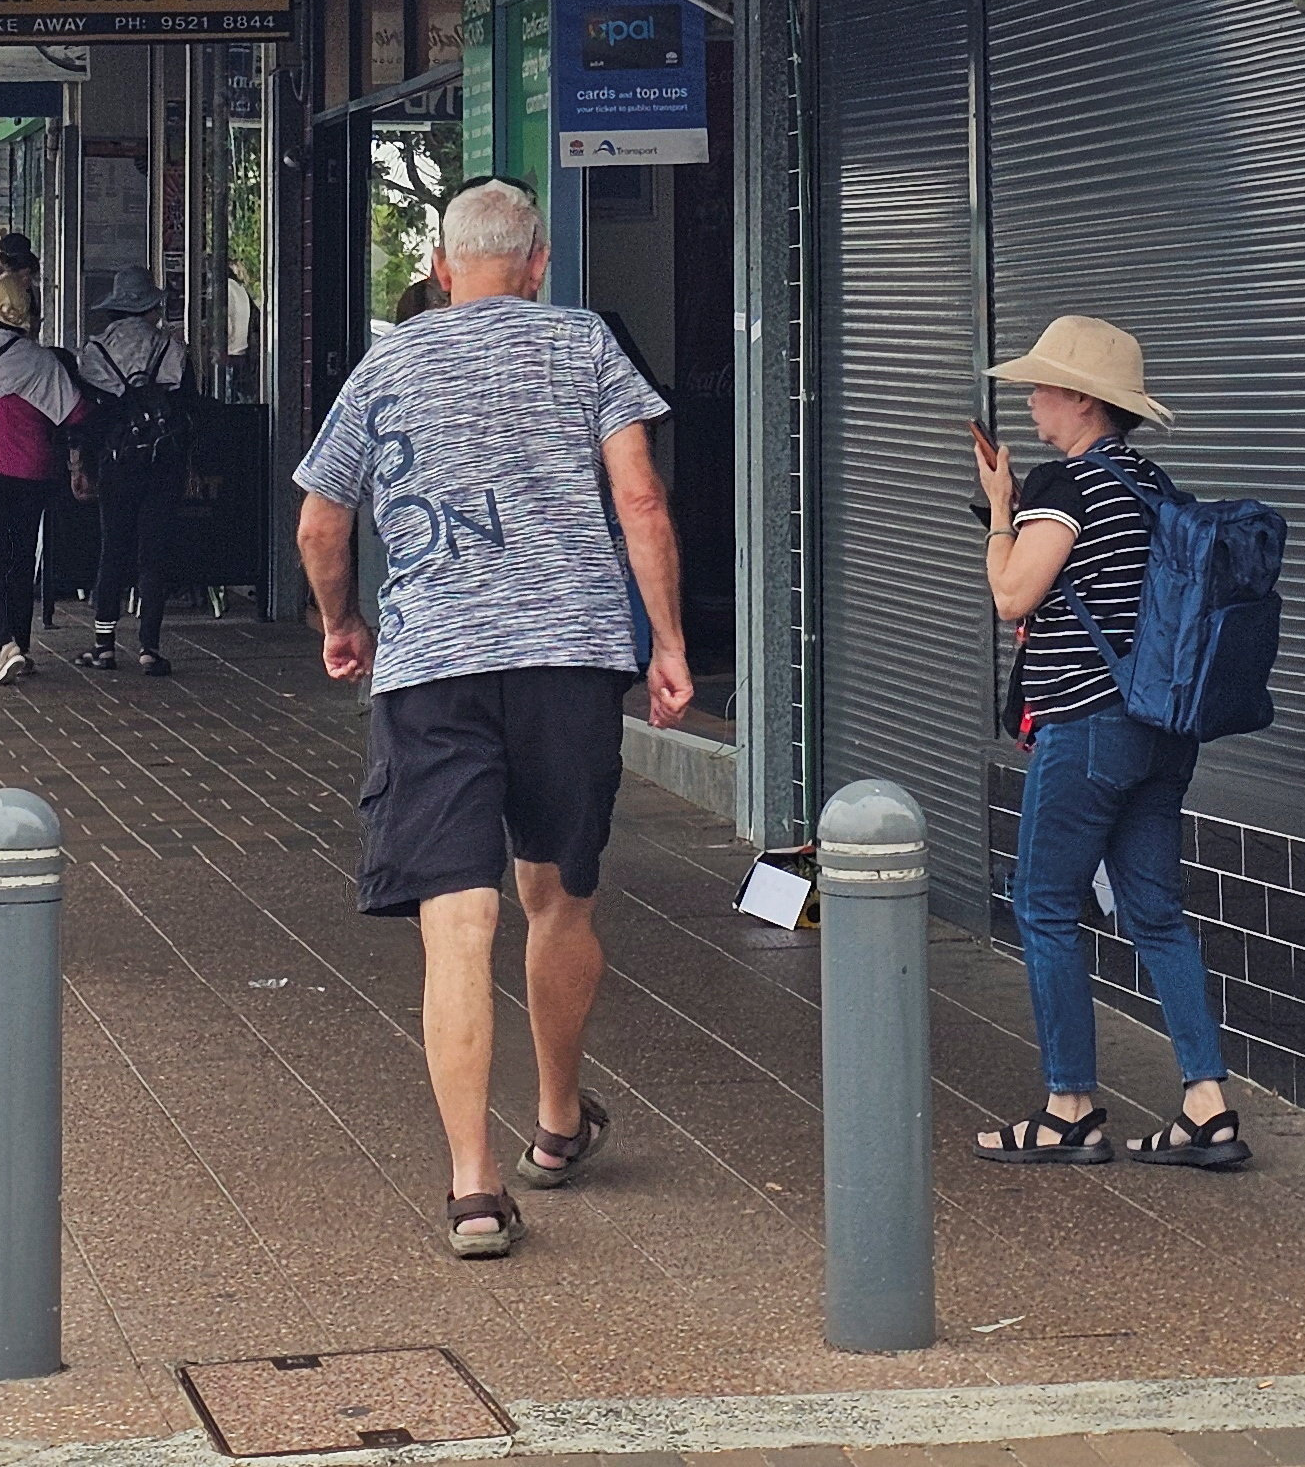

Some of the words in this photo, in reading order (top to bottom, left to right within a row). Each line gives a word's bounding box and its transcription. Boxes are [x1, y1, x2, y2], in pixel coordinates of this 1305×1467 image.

[33, 16, 88, 32] AWAY
[115, 16, 147, 31] PH:
[161, 16, 210, 31] 9521
[222, 14, 276, 30] 8844
[576, 86, 616, 100] cards
[636, 86, 659, 100] top
[662, 87, 688, 100] ups
[576, 106, 594, 114] your
[595, 104, 617, 113] ticket
[627, 104, 651, 113] public
[652, 103, 688, 112] transport
[616, 147, 658, 155] Transport
